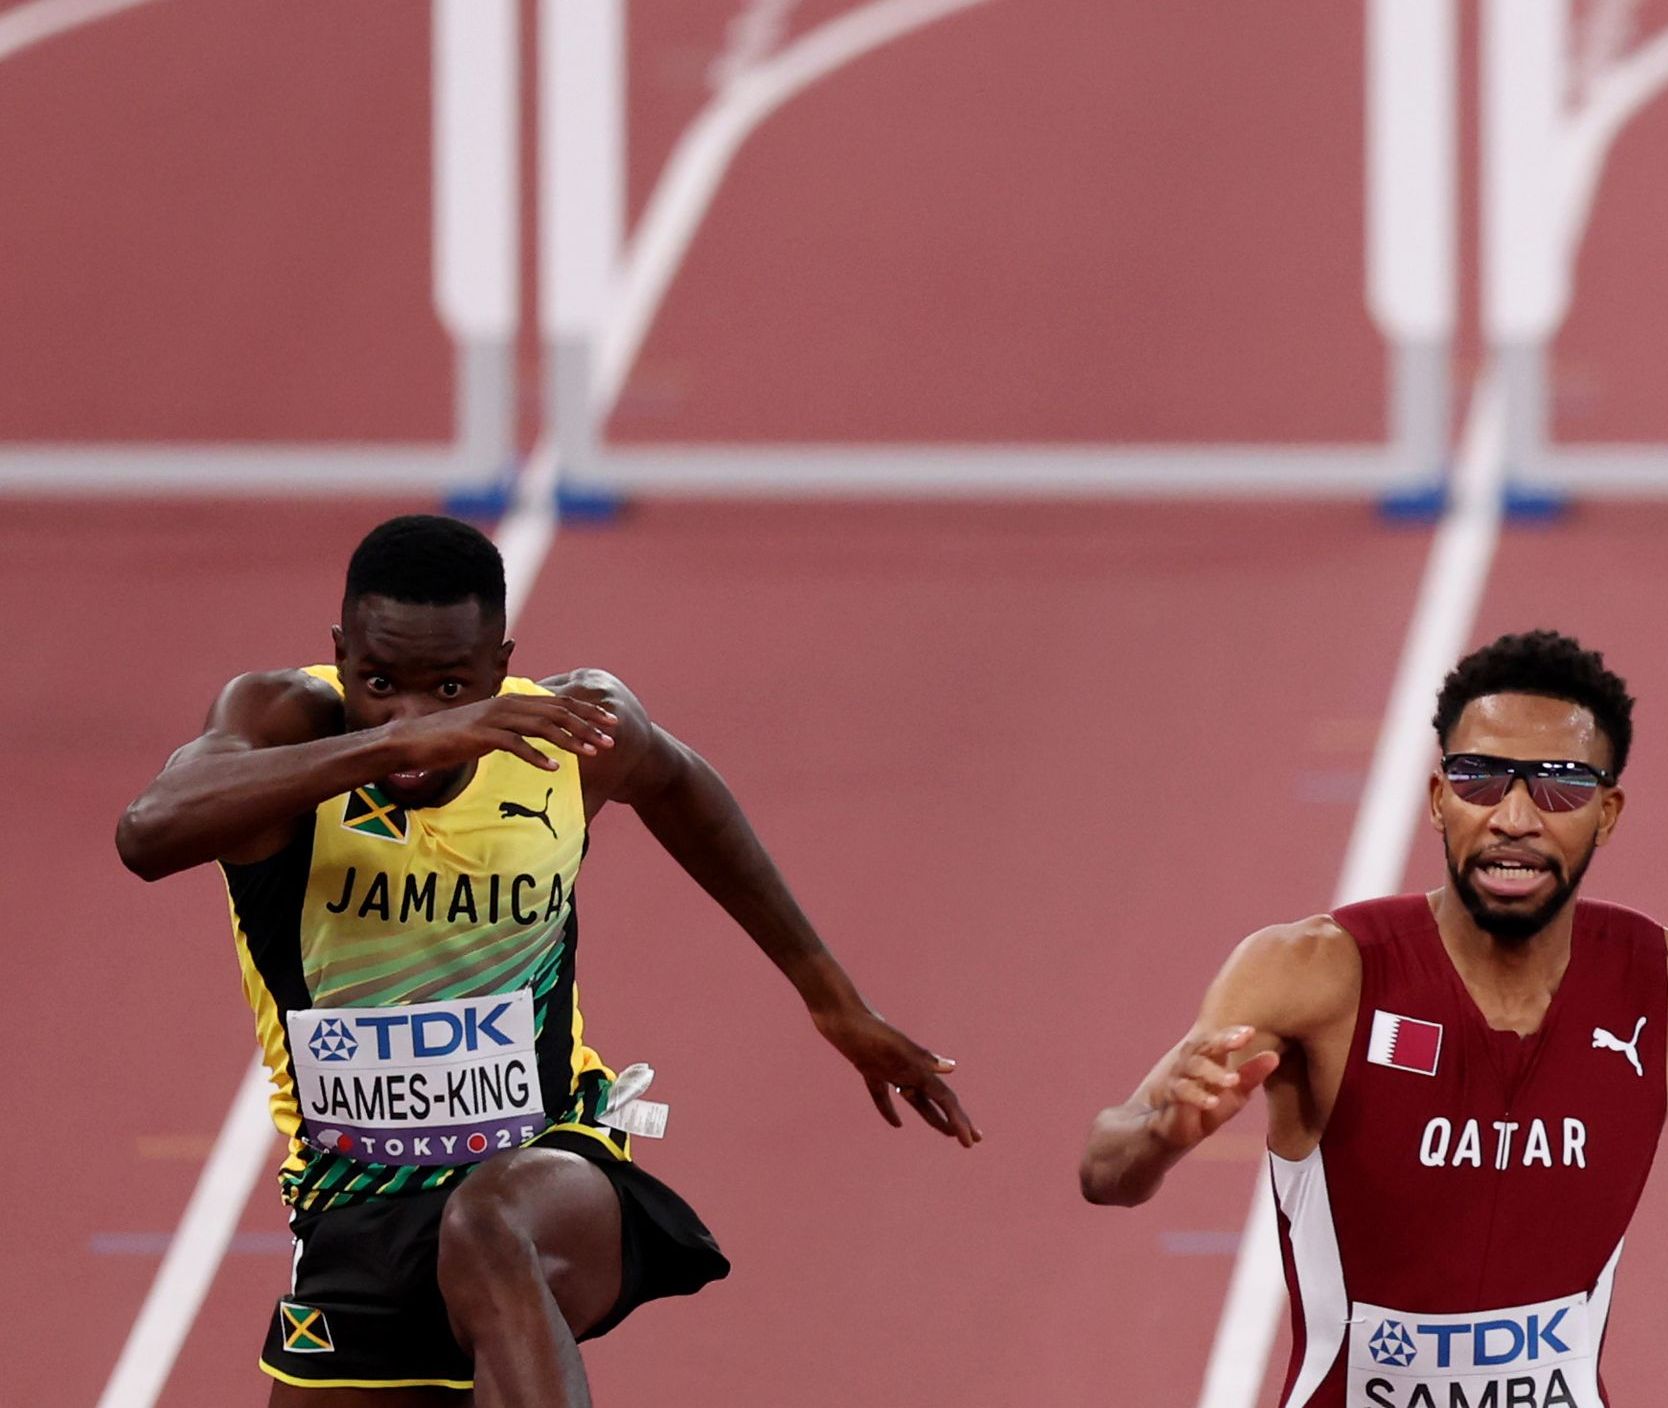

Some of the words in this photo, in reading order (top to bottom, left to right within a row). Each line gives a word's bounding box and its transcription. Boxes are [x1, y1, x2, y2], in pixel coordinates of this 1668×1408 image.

[326, 866, 566, 925] JAMAICA
[355, 1001, 516, 1061] TDK
[311, 1058, 530, 1121] JAMES-KING
[1418, 1116, 1587, 1171] QATAR
[1416, 1306, 1571, 1368] TDK
